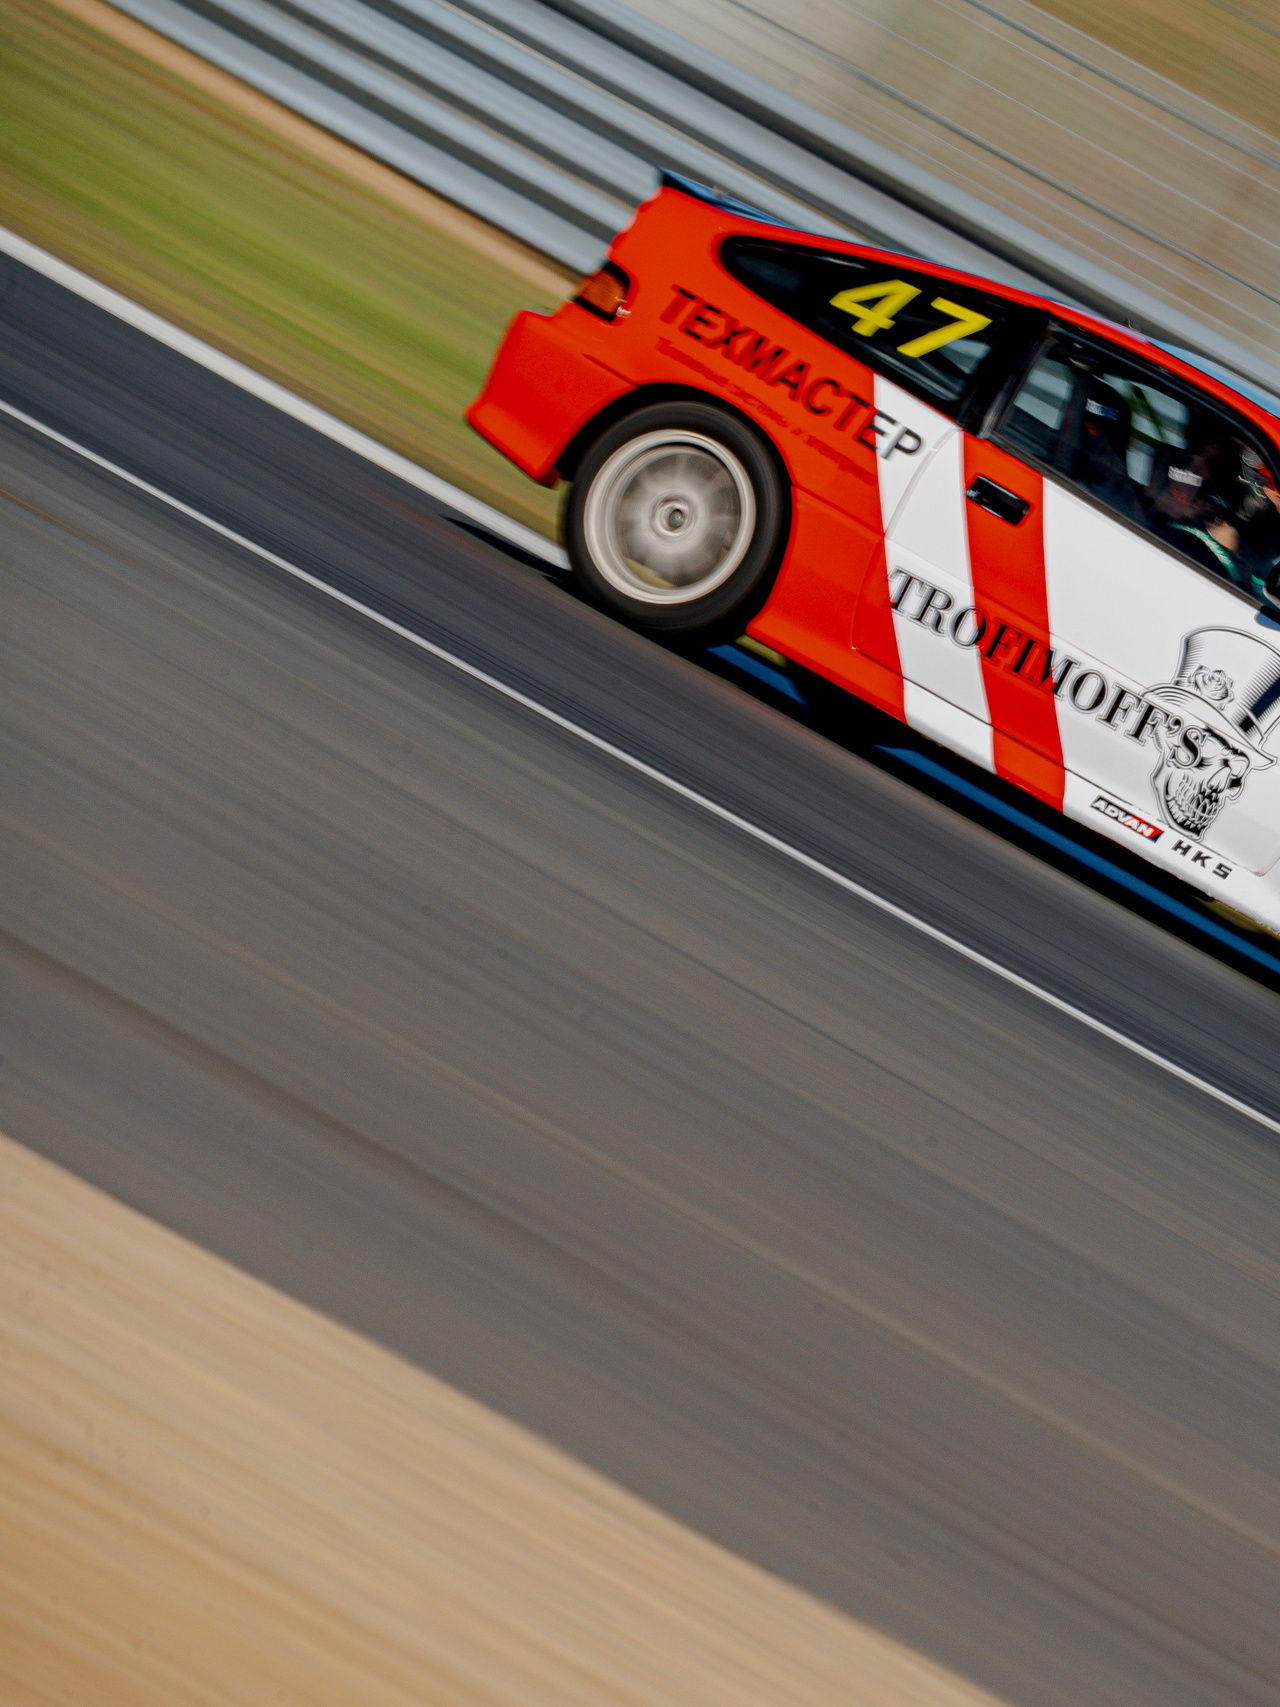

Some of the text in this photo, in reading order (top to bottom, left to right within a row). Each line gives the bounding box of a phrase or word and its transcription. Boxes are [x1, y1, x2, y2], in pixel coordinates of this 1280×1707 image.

[829, 279, 993, 358] 47
[888, 565, 1212, 770] TROFIMOFF'S
[1091, 799, 1155, 838] ADVAN
[1171, 840, 1233, 879] HKS
